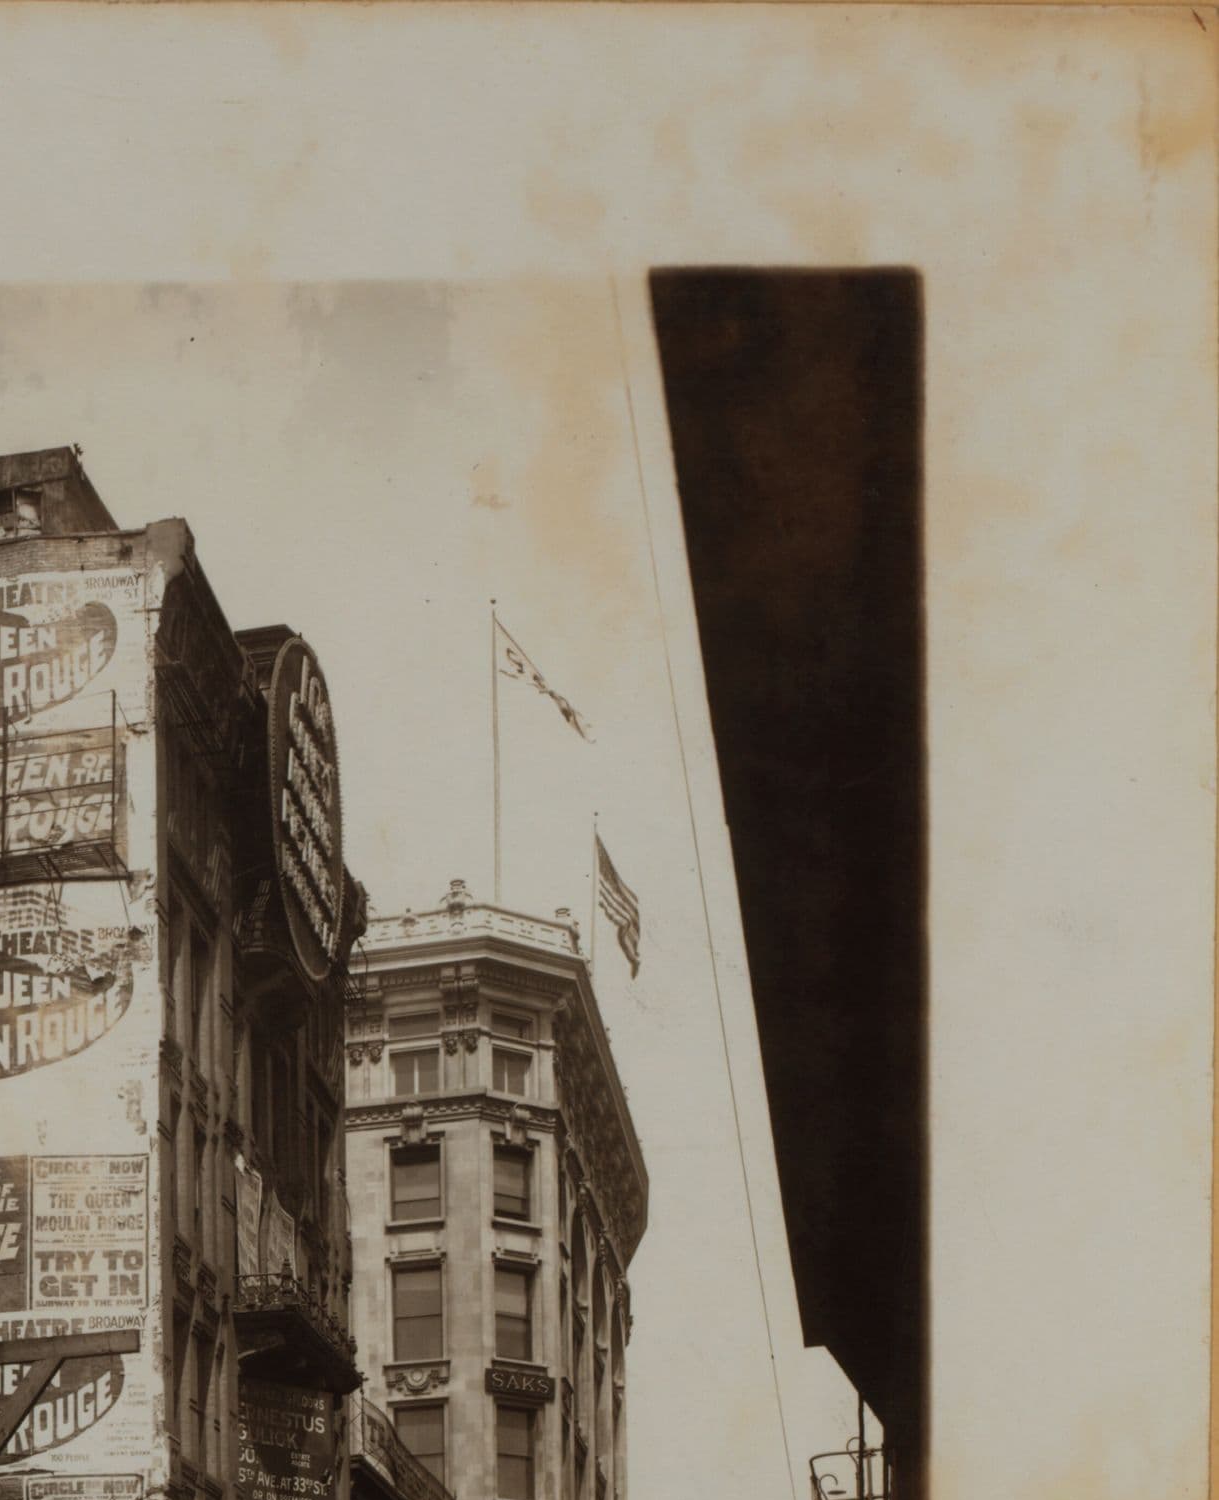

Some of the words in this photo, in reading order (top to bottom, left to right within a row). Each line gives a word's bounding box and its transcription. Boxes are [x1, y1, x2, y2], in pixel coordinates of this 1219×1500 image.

[3, 630, 107, 716] ROUGE
[109, 1159, 143, 1174] NOW
[50, 1193, 76, 1209] THE
[85, 1192, 131, 1209] QUEEN
[35, 1215, 90, 1232] MOULIN
[34, 1250, 96, 1272] TRY
[102, 1250, 143, 1272] TO
[39, 1275, 98, 1298] GET
[109, 1274, 140, 1297] IN
[88, 1314, 148, 1329] BROADWAY
[490, 1372, 551, 1395] SAKS
[280, 1477, 292, 1490] AT
[252, 1489, 263, 1500] OR
